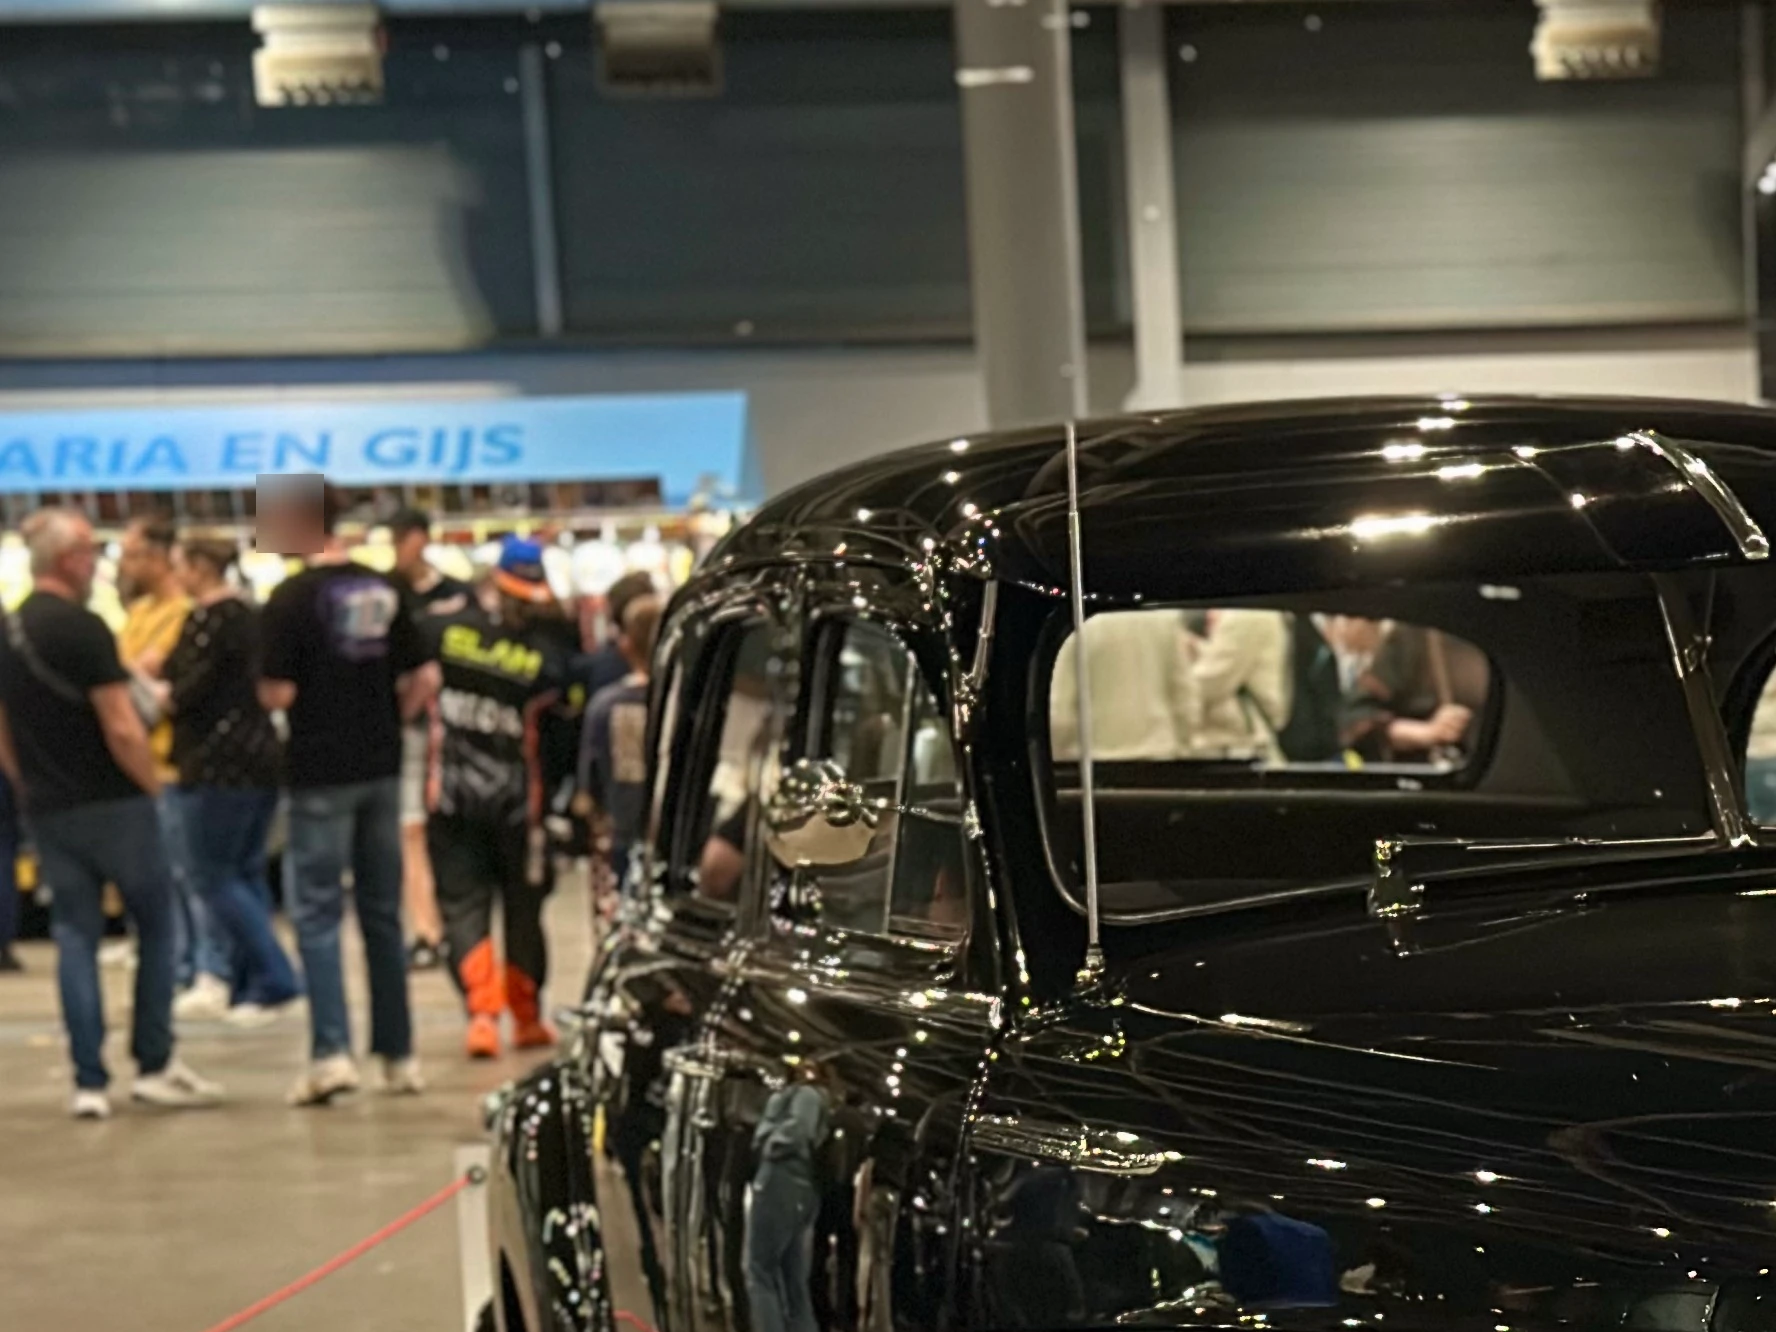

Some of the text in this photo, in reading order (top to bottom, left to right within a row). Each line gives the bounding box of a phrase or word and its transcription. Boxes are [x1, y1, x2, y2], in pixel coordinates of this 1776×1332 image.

[0, 424, 524, 479] ARIA EN GIJS
